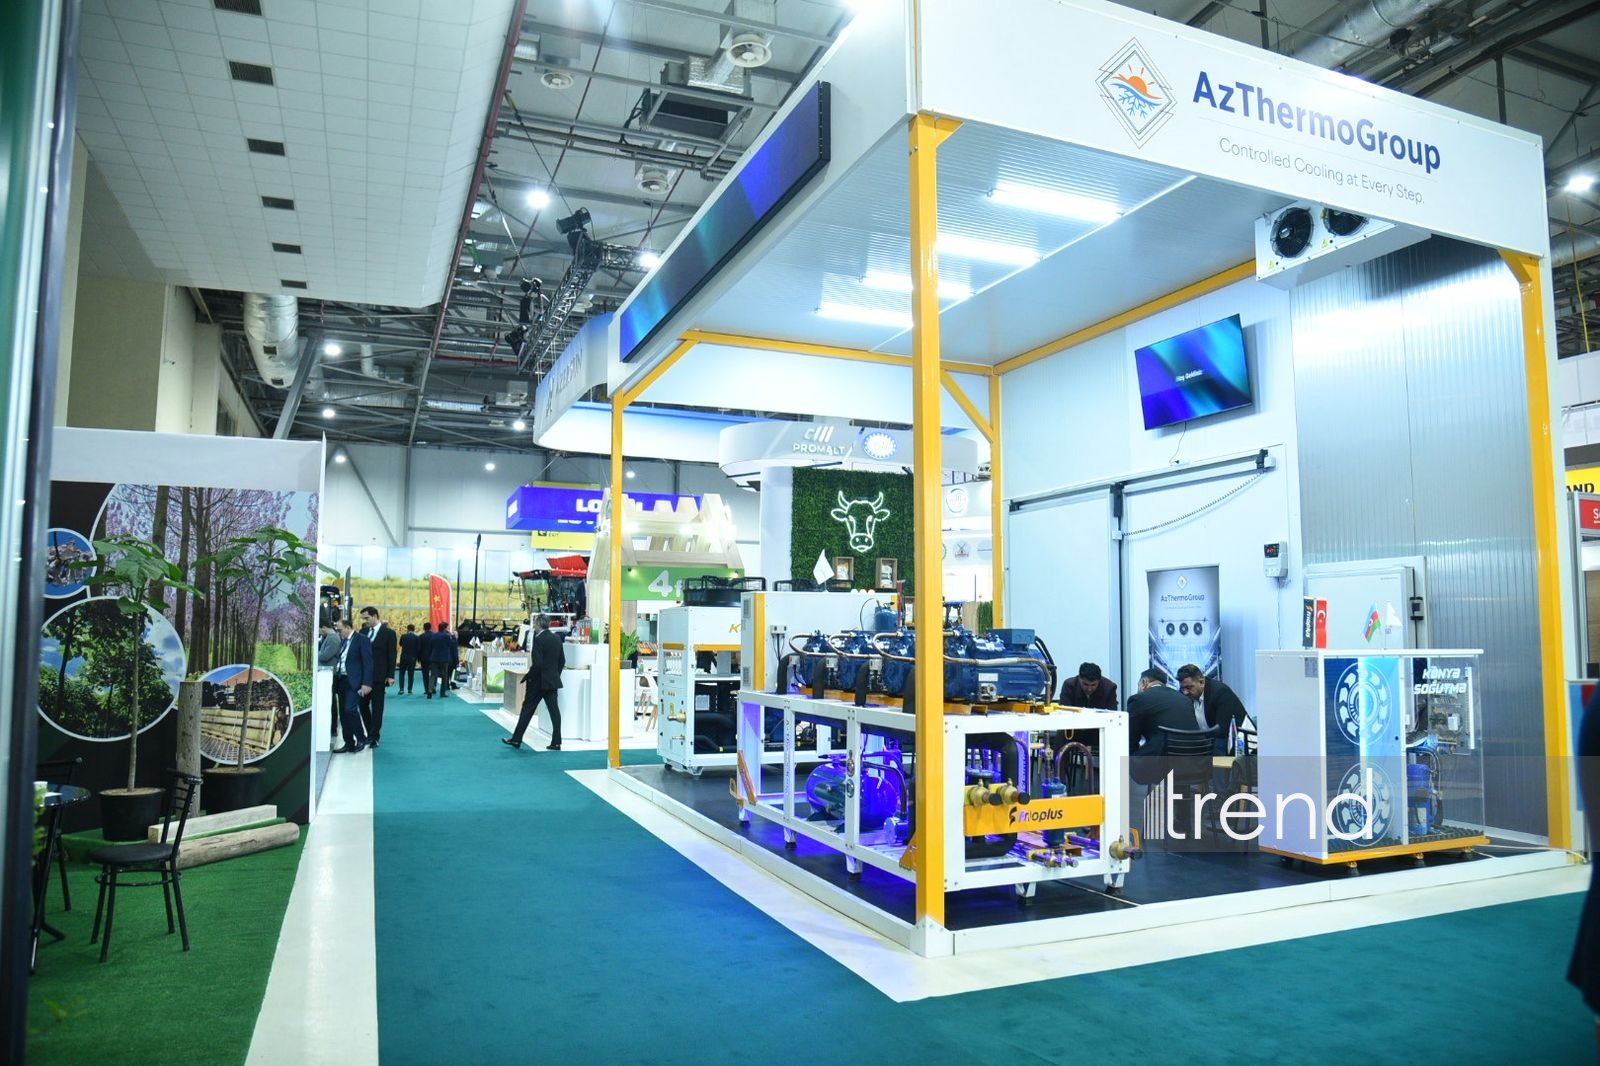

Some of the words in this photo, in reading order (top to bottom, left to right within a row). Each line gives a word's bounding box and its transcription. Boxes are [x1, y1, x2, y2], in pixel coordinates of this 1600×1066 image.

[1193, 70, 1441, 173] AzThermoGroup
[1219, 137, 1291, 169] Controlled
[1294, 156, 1344, 186] Cooling
[1347, 172, 1359, 188] at
[1361, 175, 1394, 198] Every
[1396, 183, 1426, 205] Step.
[793, 443, 845, 455] PROMALT
